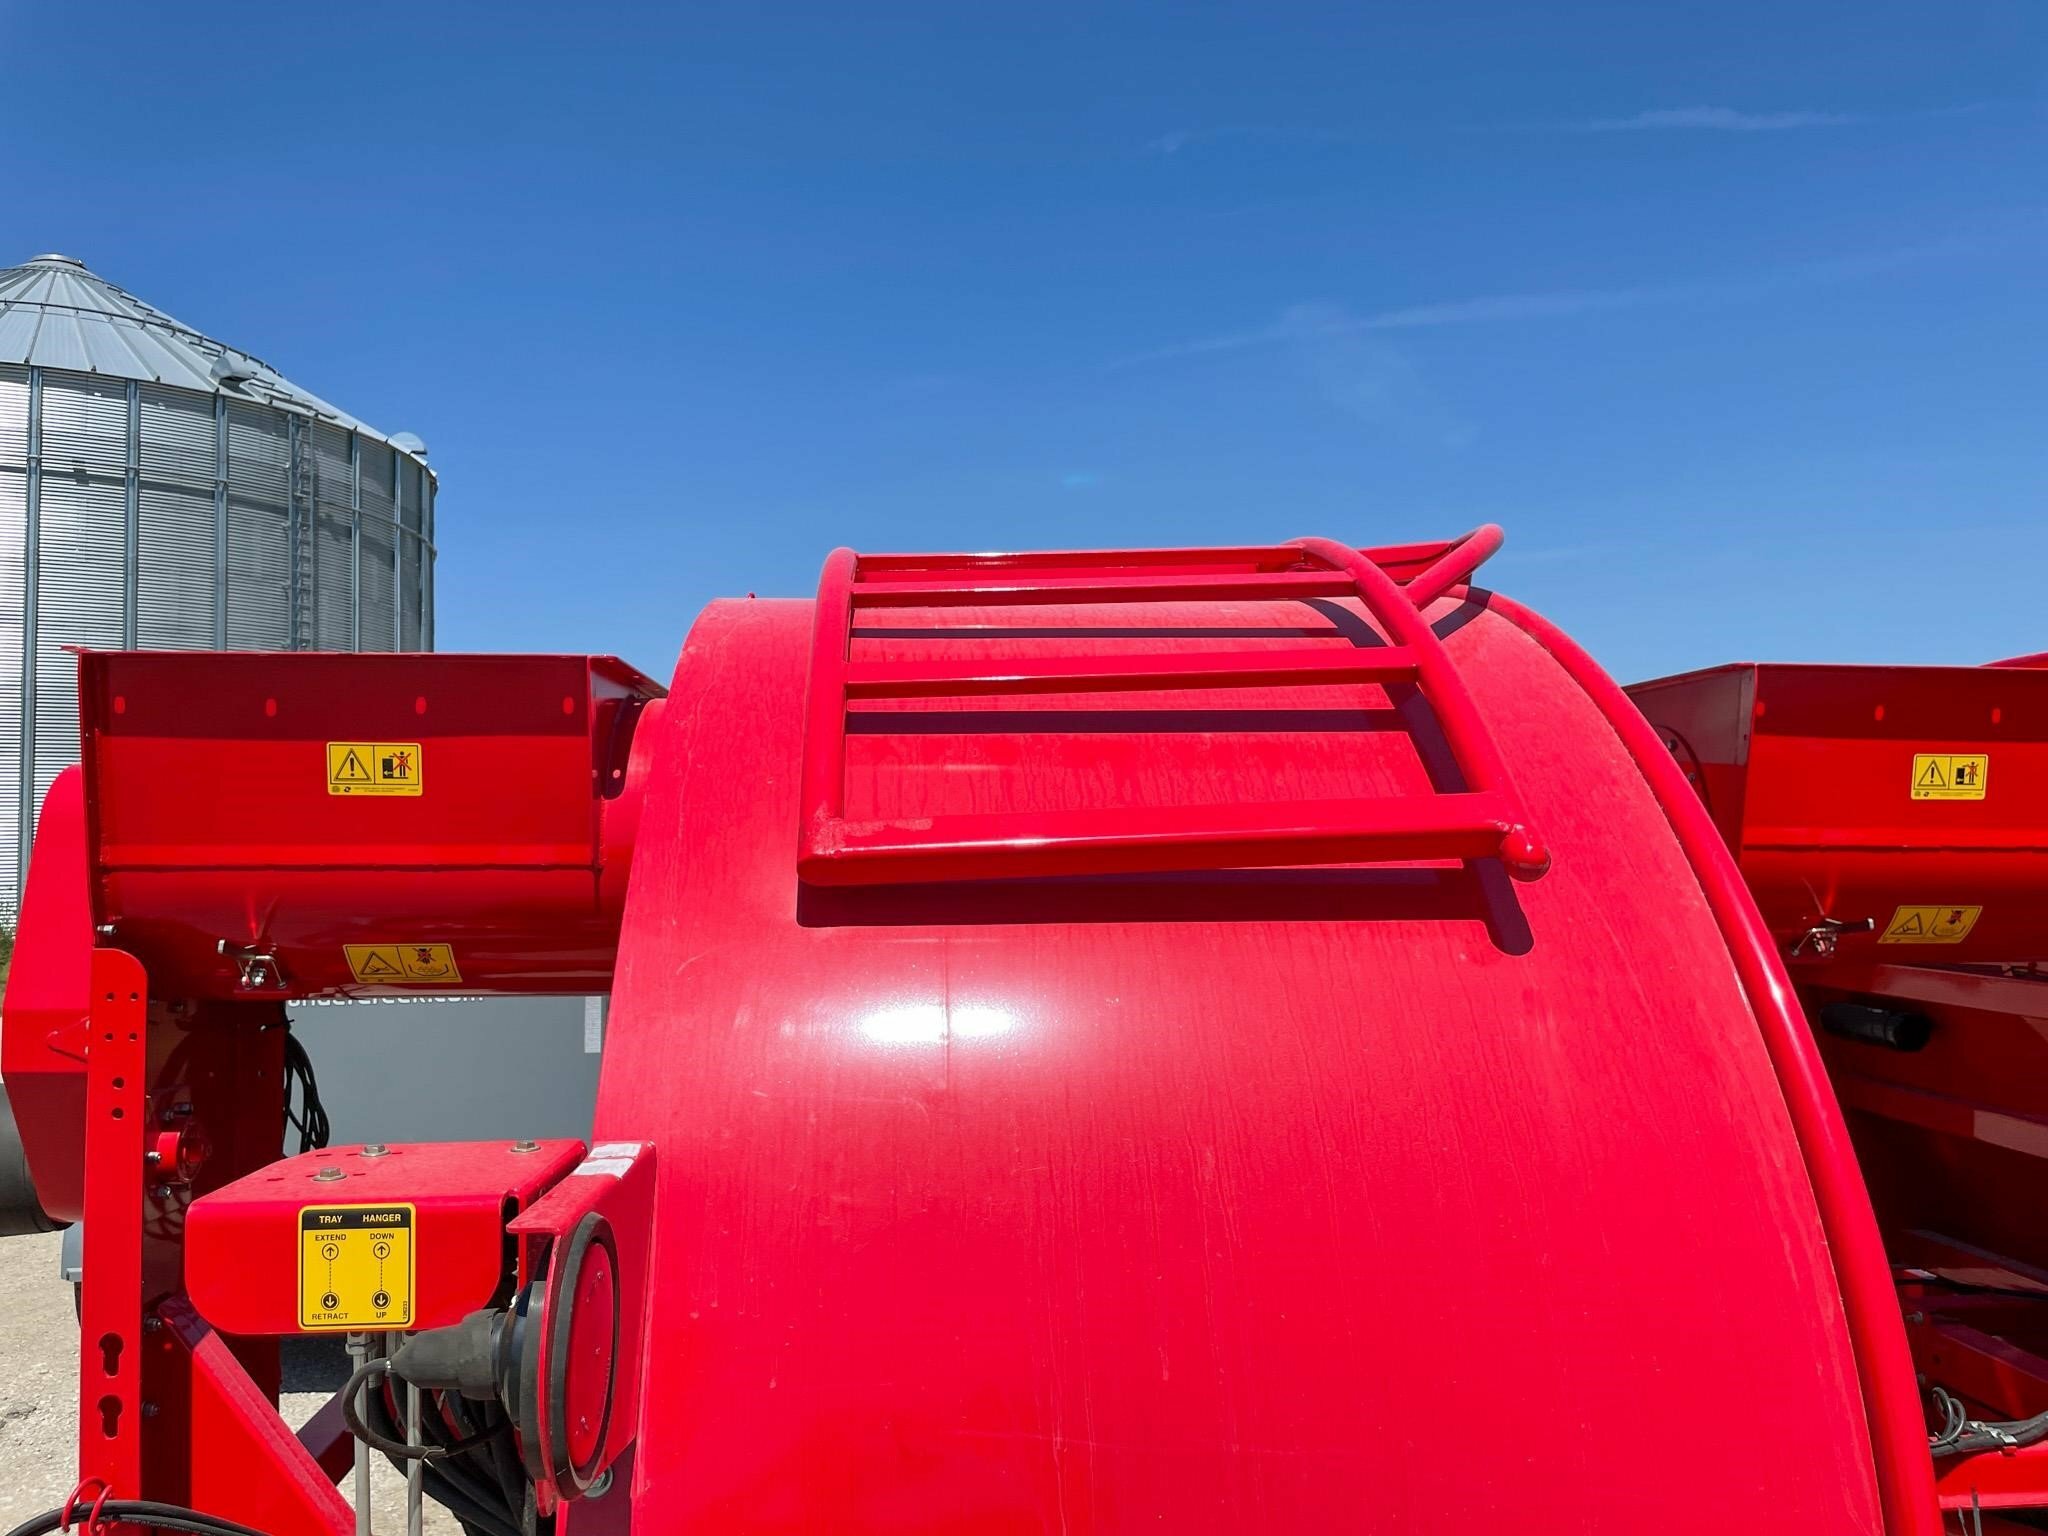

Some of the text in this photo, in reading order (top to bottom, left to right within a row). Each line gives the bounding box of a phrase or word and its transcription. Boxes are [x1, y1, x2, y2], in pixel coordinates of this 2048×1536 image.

[319, 1213, 402, 1224] TRAY HANGER
[311, 1312, 349, 1320] RETRACT
[375, 1311, 387, 1319] UP
